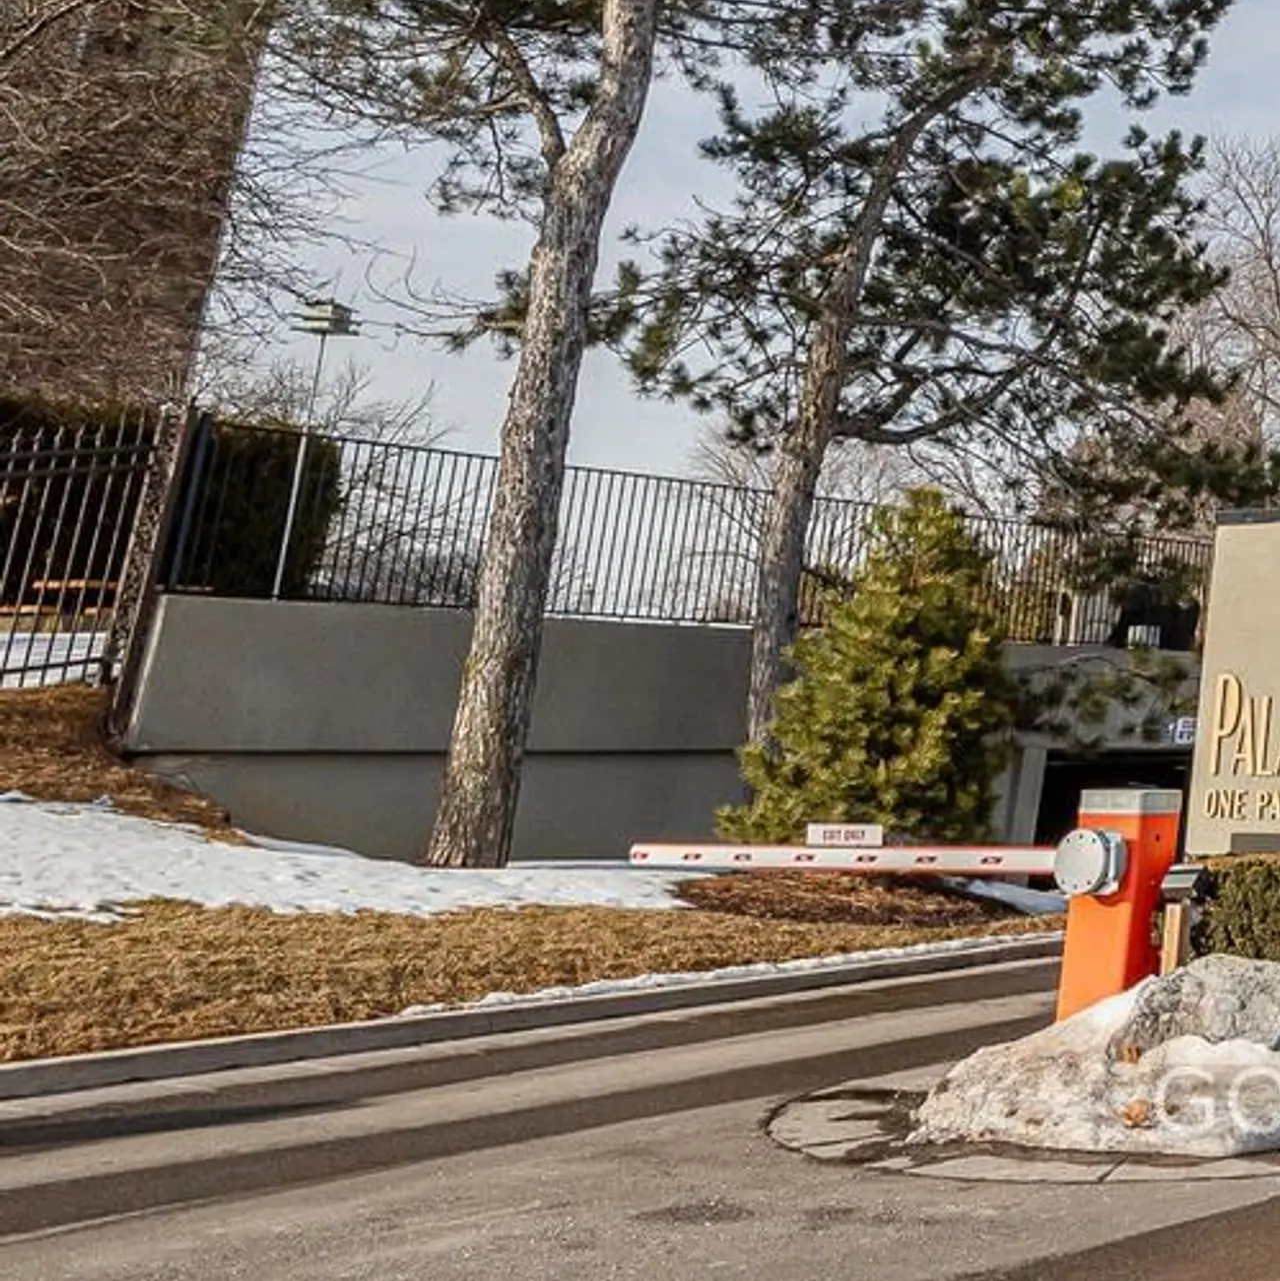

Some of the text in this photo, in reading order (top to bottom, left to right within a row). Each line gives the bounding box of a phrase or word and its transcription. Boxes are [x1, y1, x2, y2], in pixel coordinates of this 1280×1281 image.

[1204, 789, 1249, 820] ONE
[822, 829, 865, 842] EXIT ONLY
